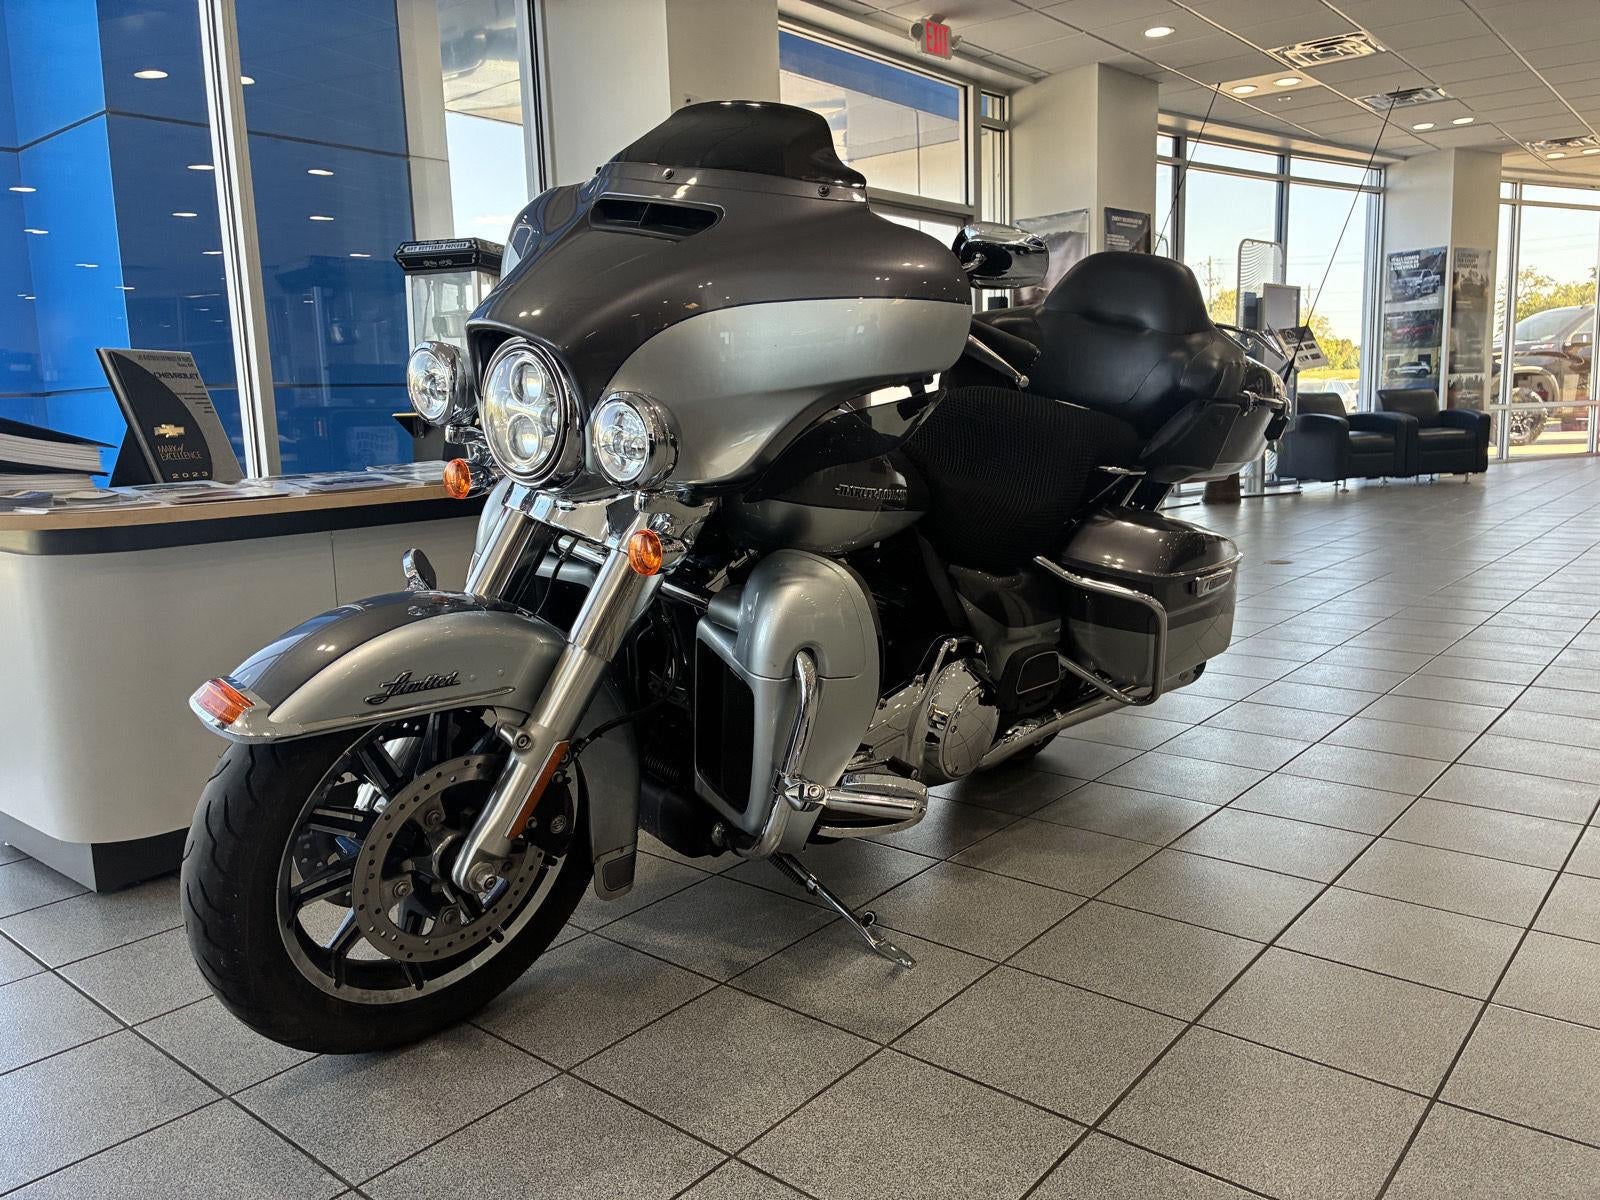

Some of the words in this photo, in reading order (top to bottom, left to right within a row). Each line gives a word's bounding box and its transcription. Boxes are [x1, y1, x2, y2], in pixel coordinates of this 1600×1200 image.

[926, 20, 949, 57] EXIT
[444, 242, 468, 250] POPCORN
[153, 371, 199, 380] CHEVROLET
[157, 445, 177, 453] MARK
[160, 450, 202, 461] EXCELLENCE
[171, 470, 209, 479] 2023
[364, 670, 461, 705] Limited
